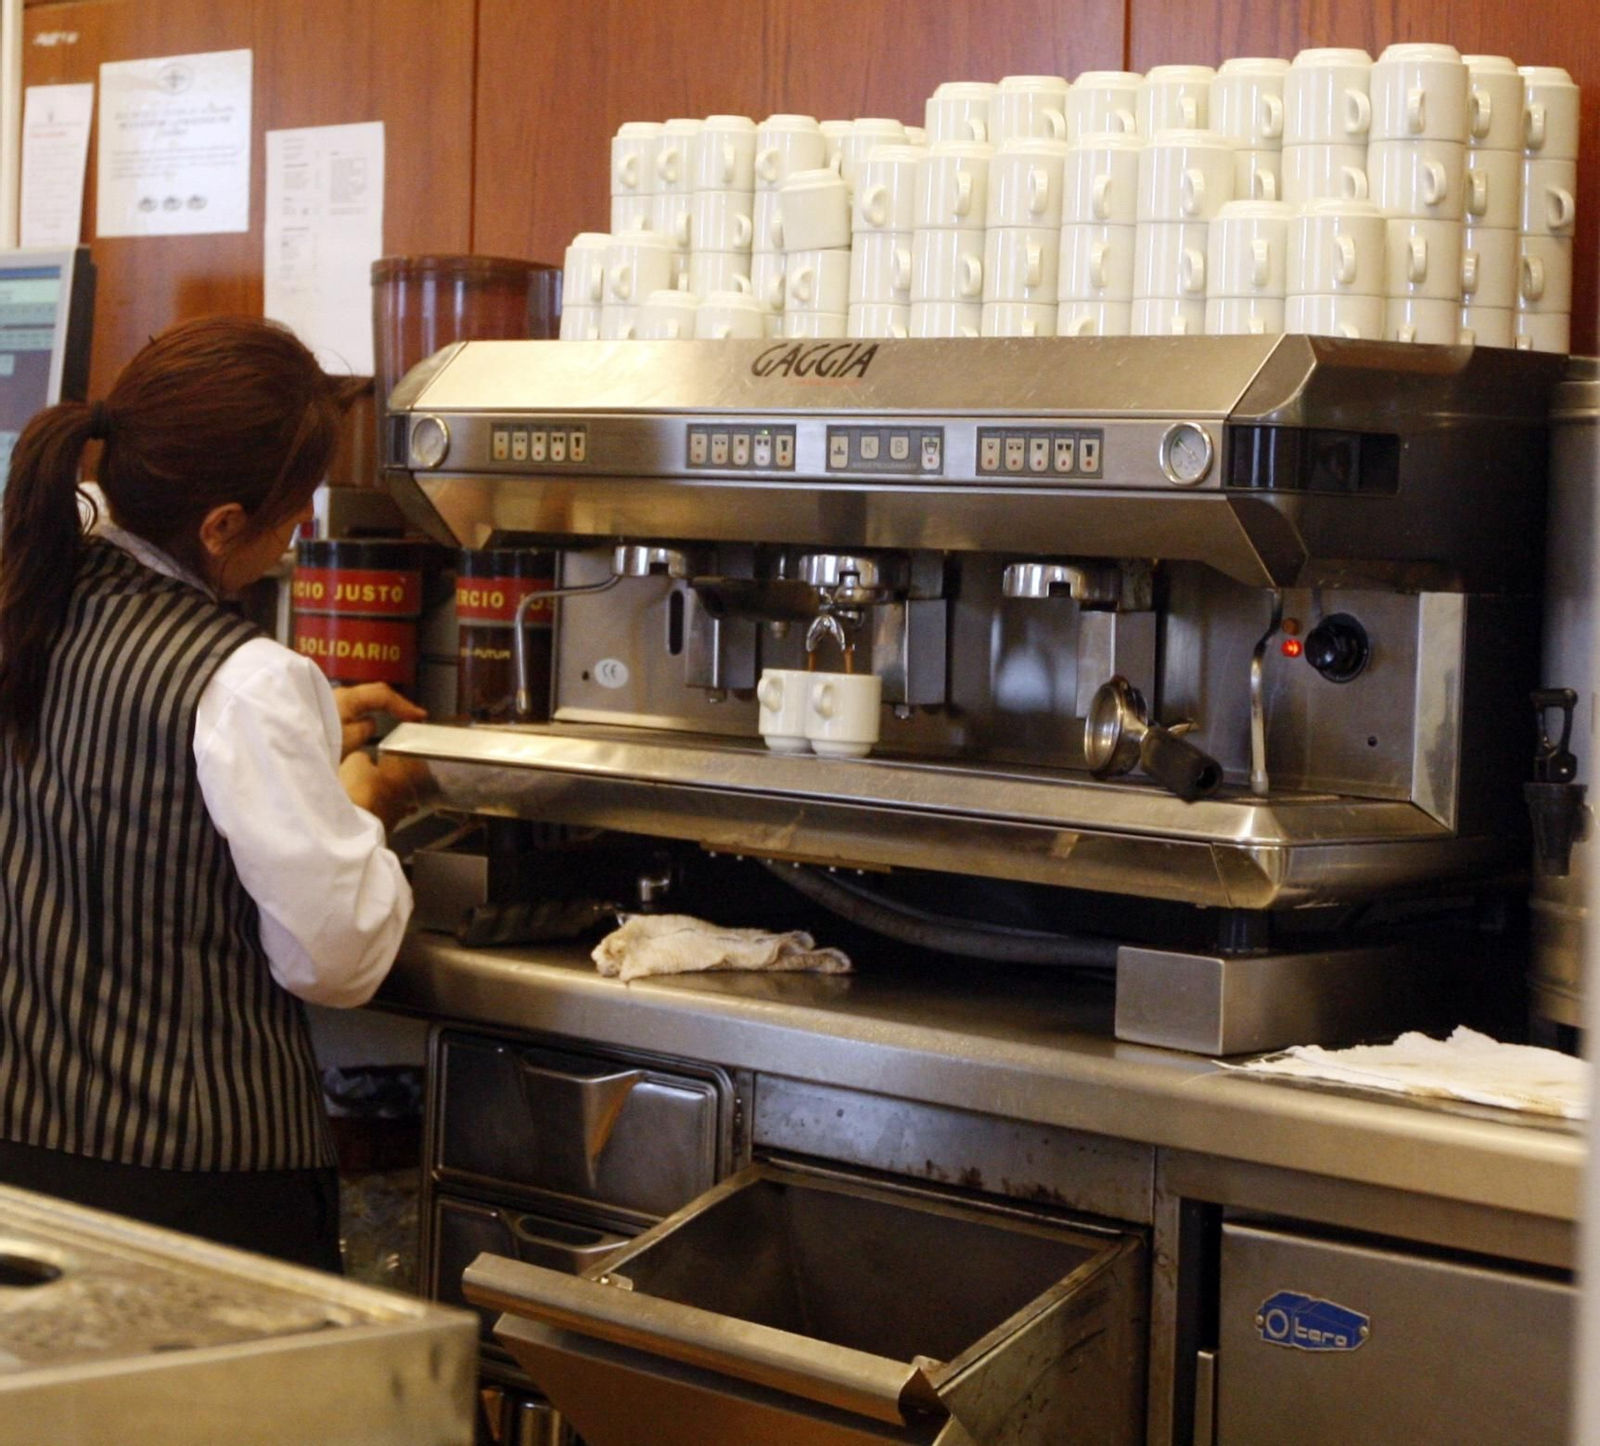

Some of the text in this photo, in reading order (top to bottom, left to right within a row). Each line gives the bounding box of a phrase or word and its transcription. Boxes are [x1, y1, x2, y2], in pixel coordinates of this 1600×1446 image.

[751, 342, 880, 378] GAGGIA
[334, 583, 403, 603] JUSTO
[299, 637, 401, 661] SOLIDARIO
